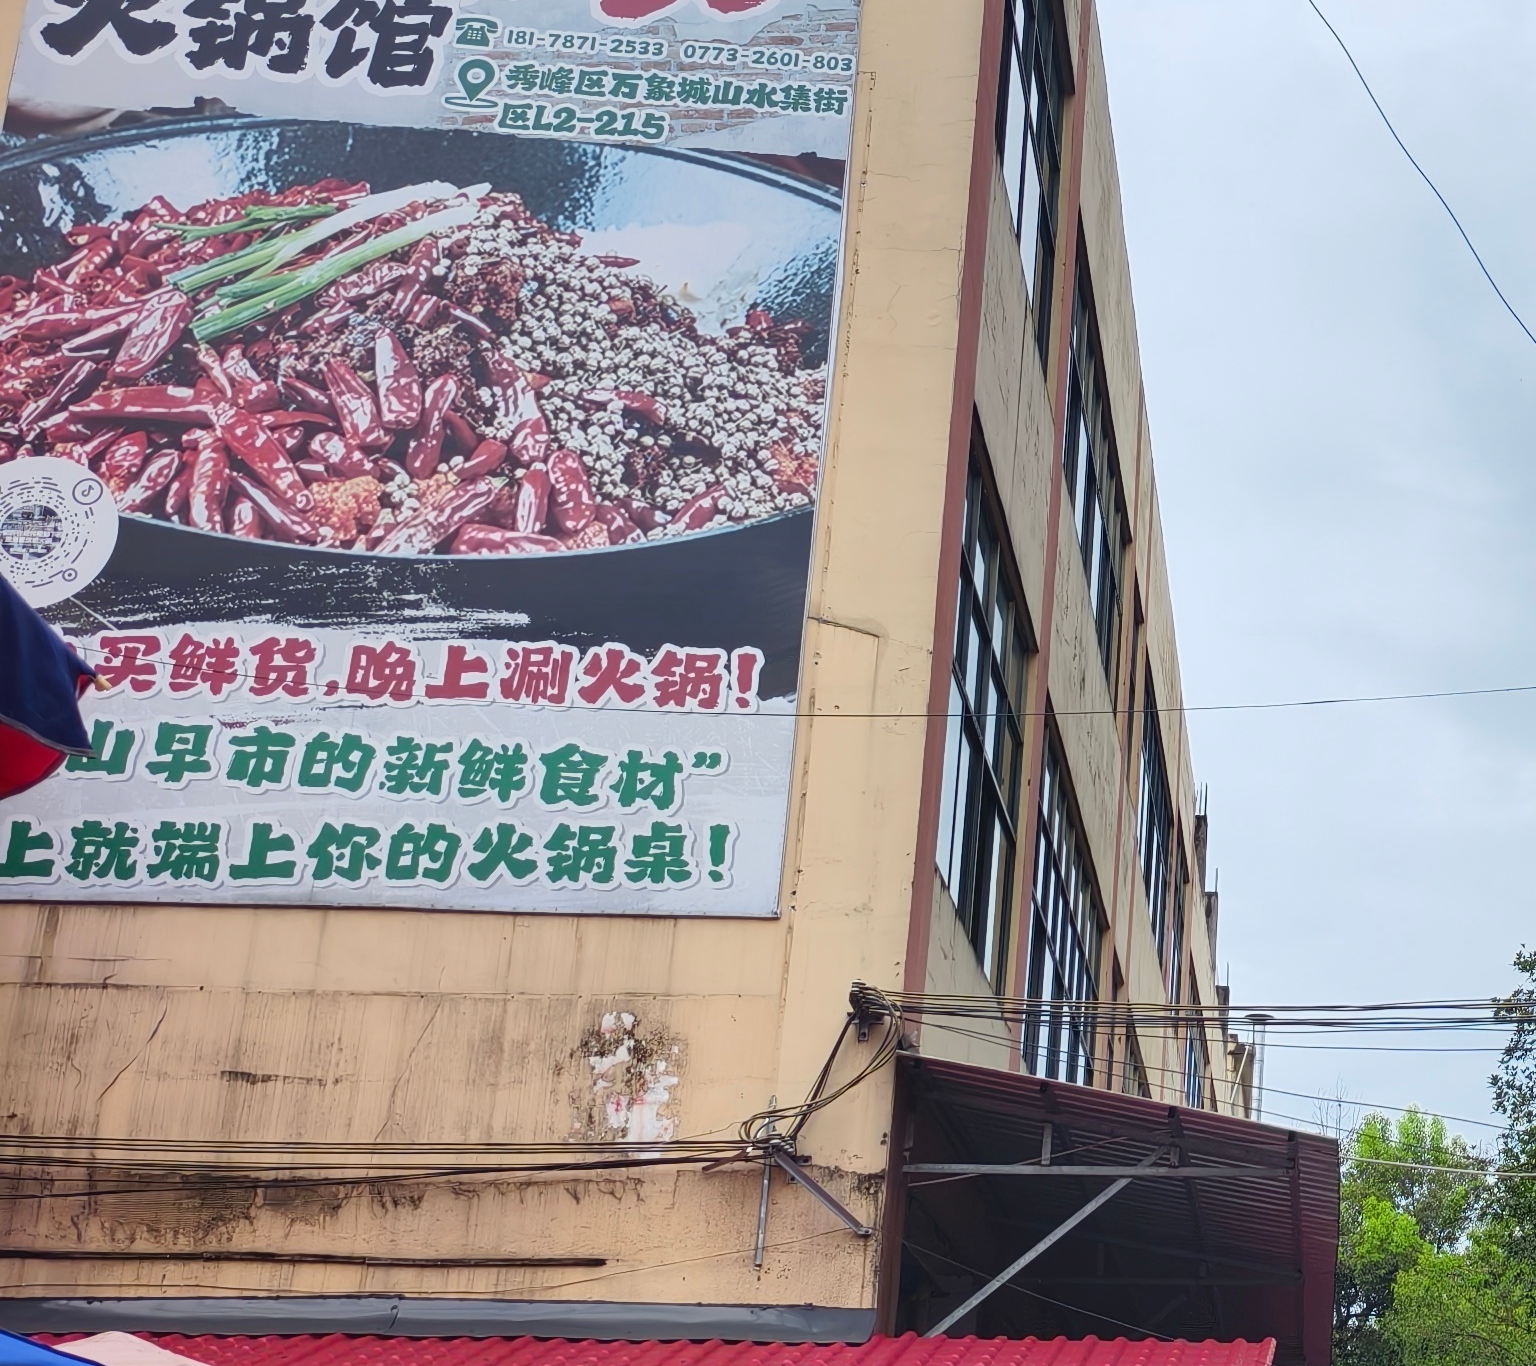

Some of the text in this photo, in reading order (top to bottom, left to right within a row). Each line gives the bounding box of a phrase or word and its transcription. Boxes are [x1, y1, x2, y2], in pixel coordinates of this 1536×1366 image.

[507, 29, 853, 72] 181-7871-2533 0773-2601-803
[505, 63, 848, 115] 秀峰区万象城山水集街
[499, 103, 666, 139] 区L2-215
[66, 634, 758, 709] 买鲜货,晚上涮火锅!
